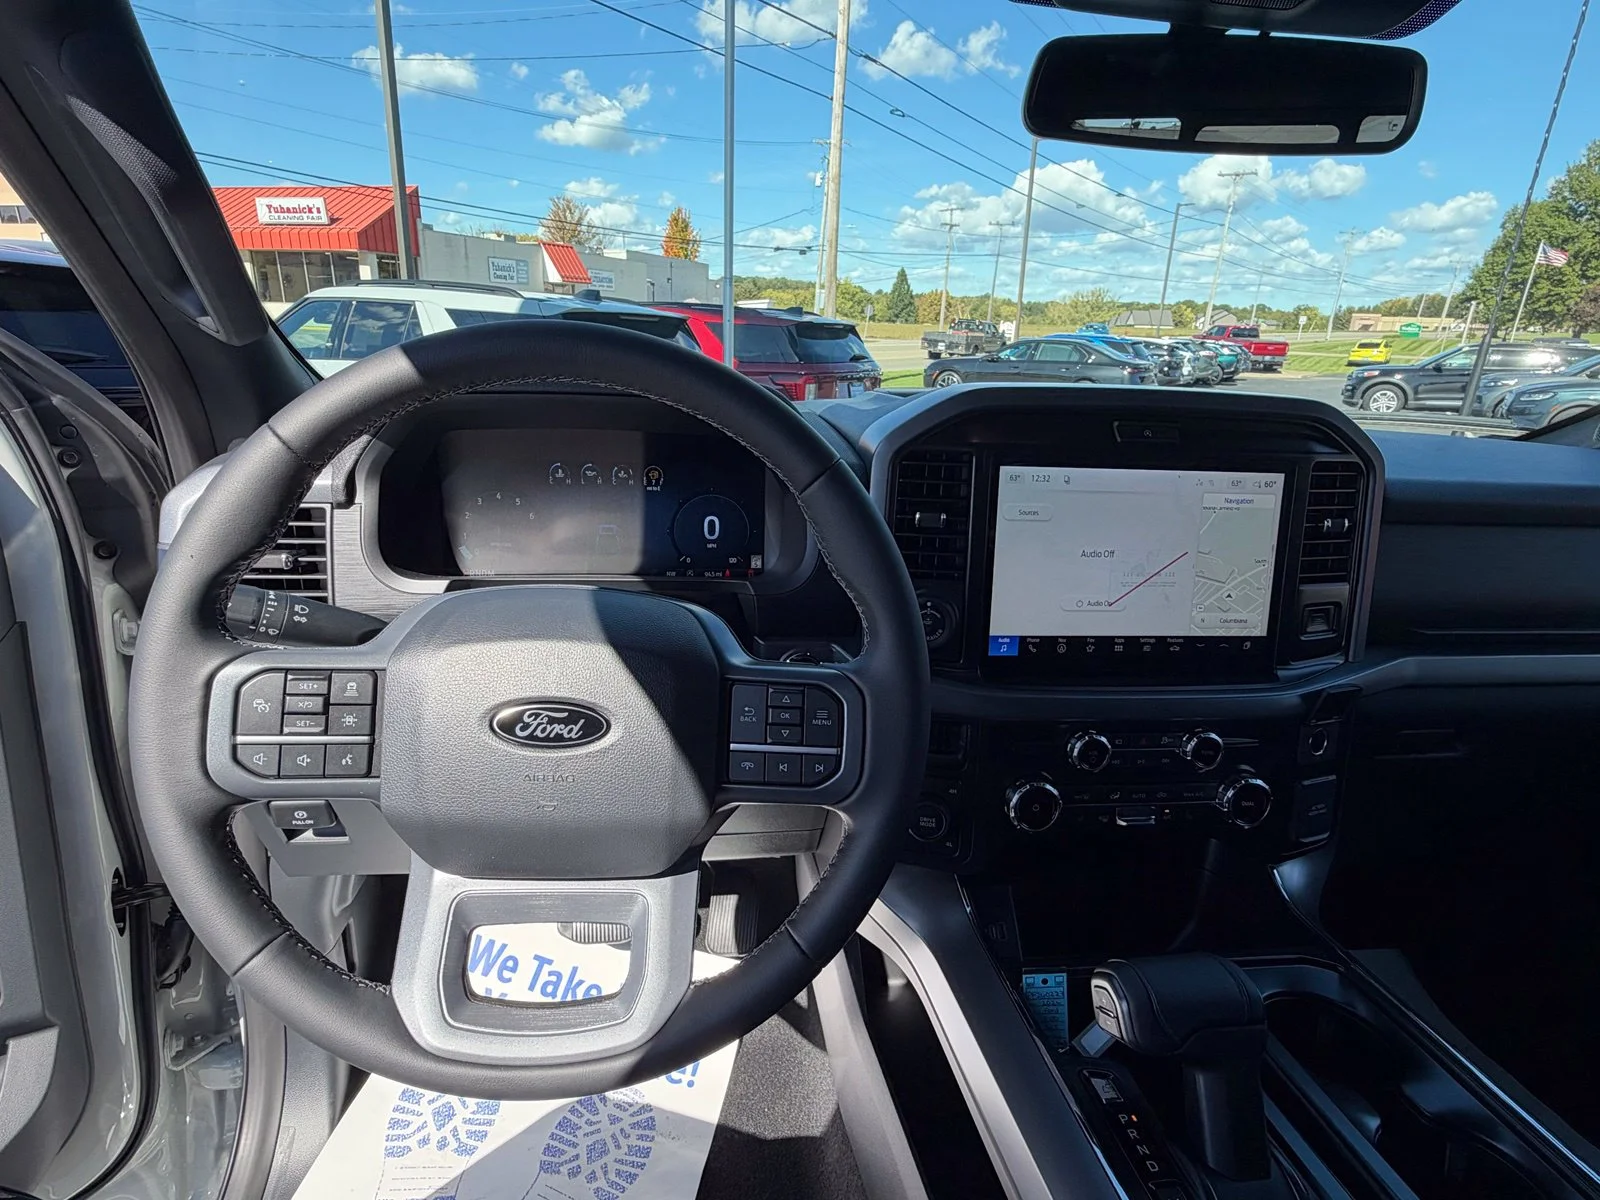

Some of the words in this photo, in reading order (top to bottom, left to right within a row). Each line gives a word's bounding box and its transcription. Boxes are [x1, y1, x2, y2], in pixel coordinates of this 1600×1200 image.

[1031, 474, 1051, 482] 12:32
[703, 515, 720, 540] 0
[1080, 550, 1101, 558] Audio
[1102, 550, 1115, 558] Off
[515, 710, 585, 739] Ford
[523, 773, 576, 783] AIRBAG
[468, 934, 519, 984] We
[528, 954, 602, 1002] Take
[1118, 1114, 1128, 1124] P
[1128, 1129, 1140, 1139] R
[1136, 1145, 1150, 1155] N
[1146, 1161, 1159, 1172] D
